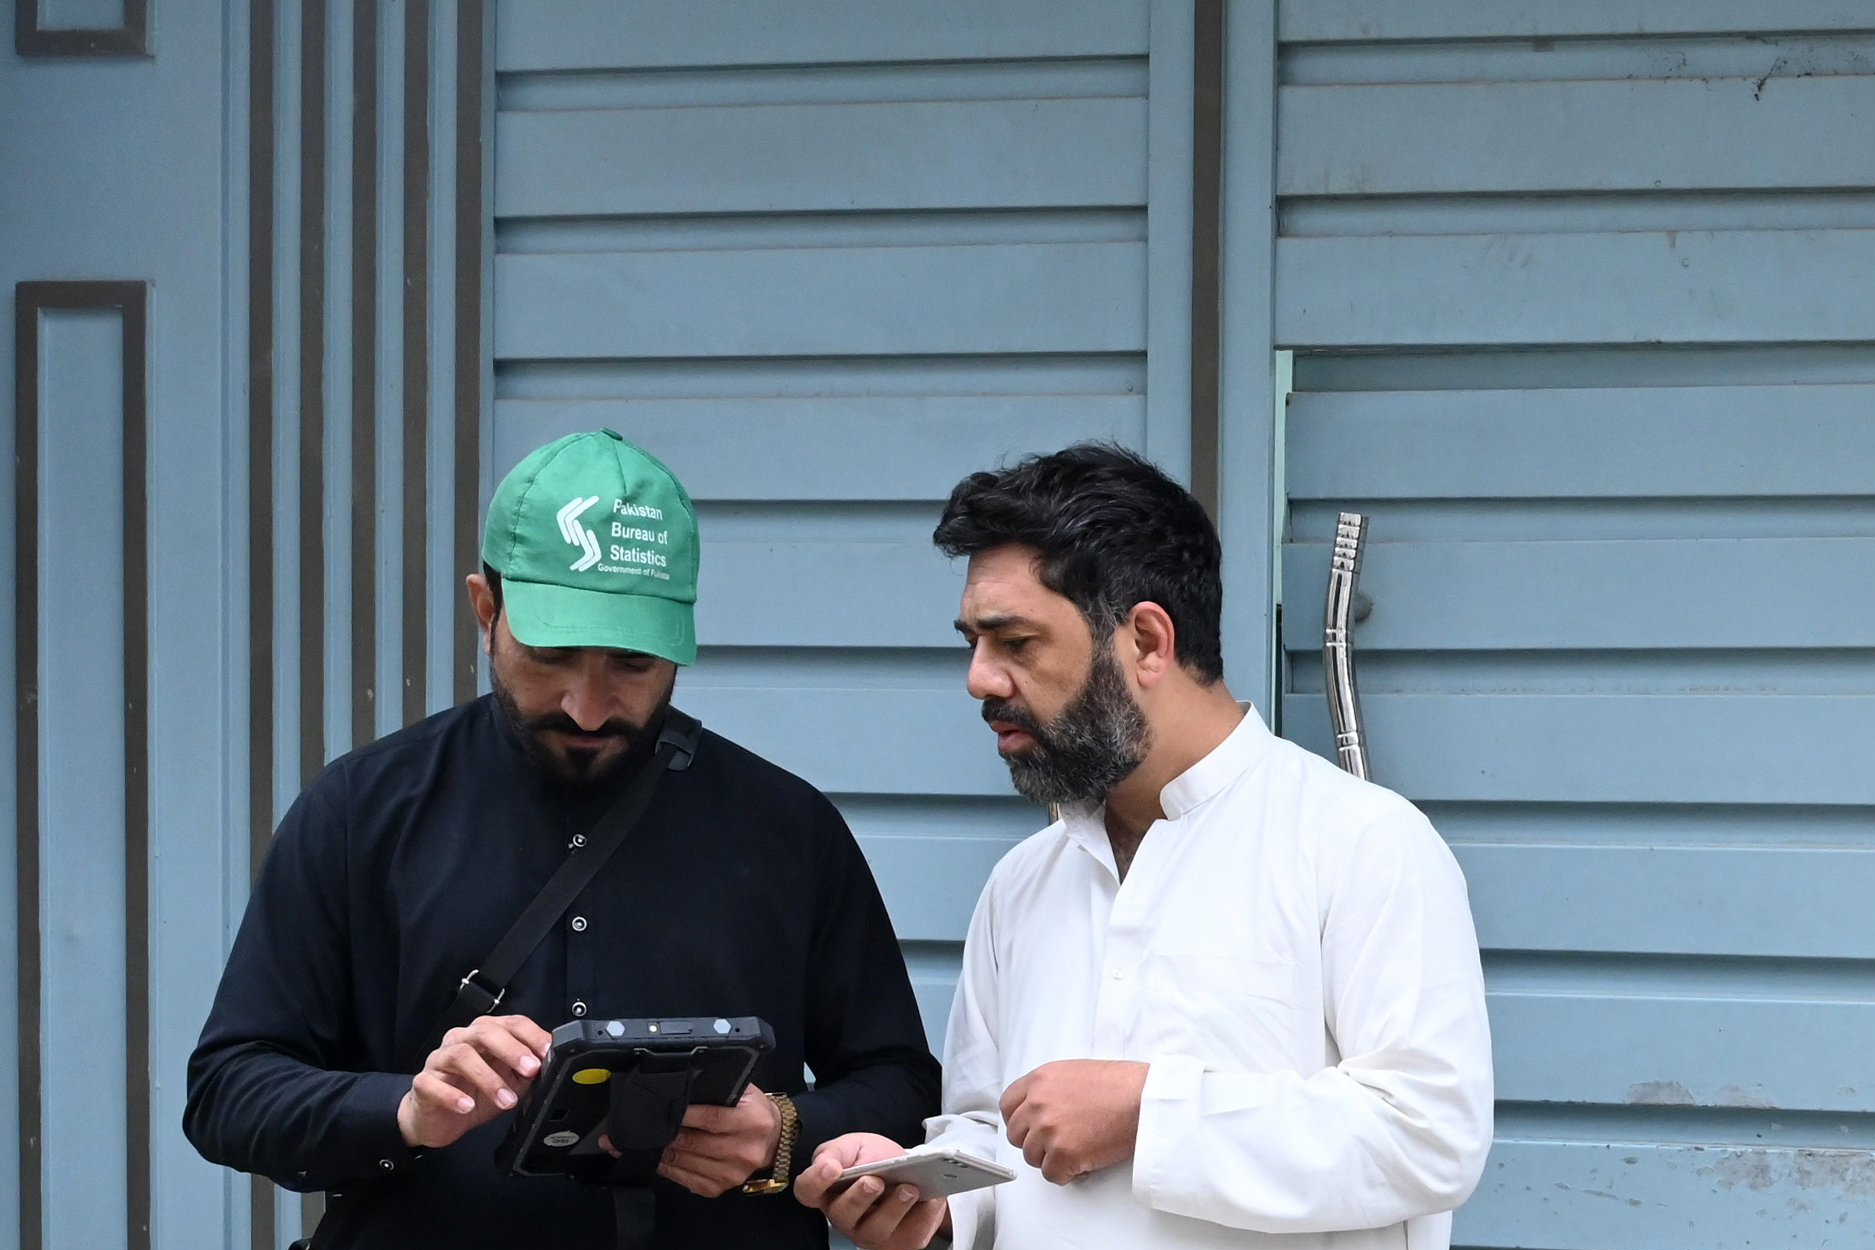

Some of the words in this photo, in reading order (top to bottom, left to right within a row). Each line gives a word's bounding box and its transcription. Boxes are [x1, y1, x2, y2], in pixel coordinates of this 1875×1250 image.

[613, 498, 663, 521] Pakistan
[611, 521, 655, 542] Bureau
[657, 530, 668, 545] of
[609, 544, 667, 568] Statistics
[597, 563, 642, 575] Government
[642, 568, 650, 576] of
